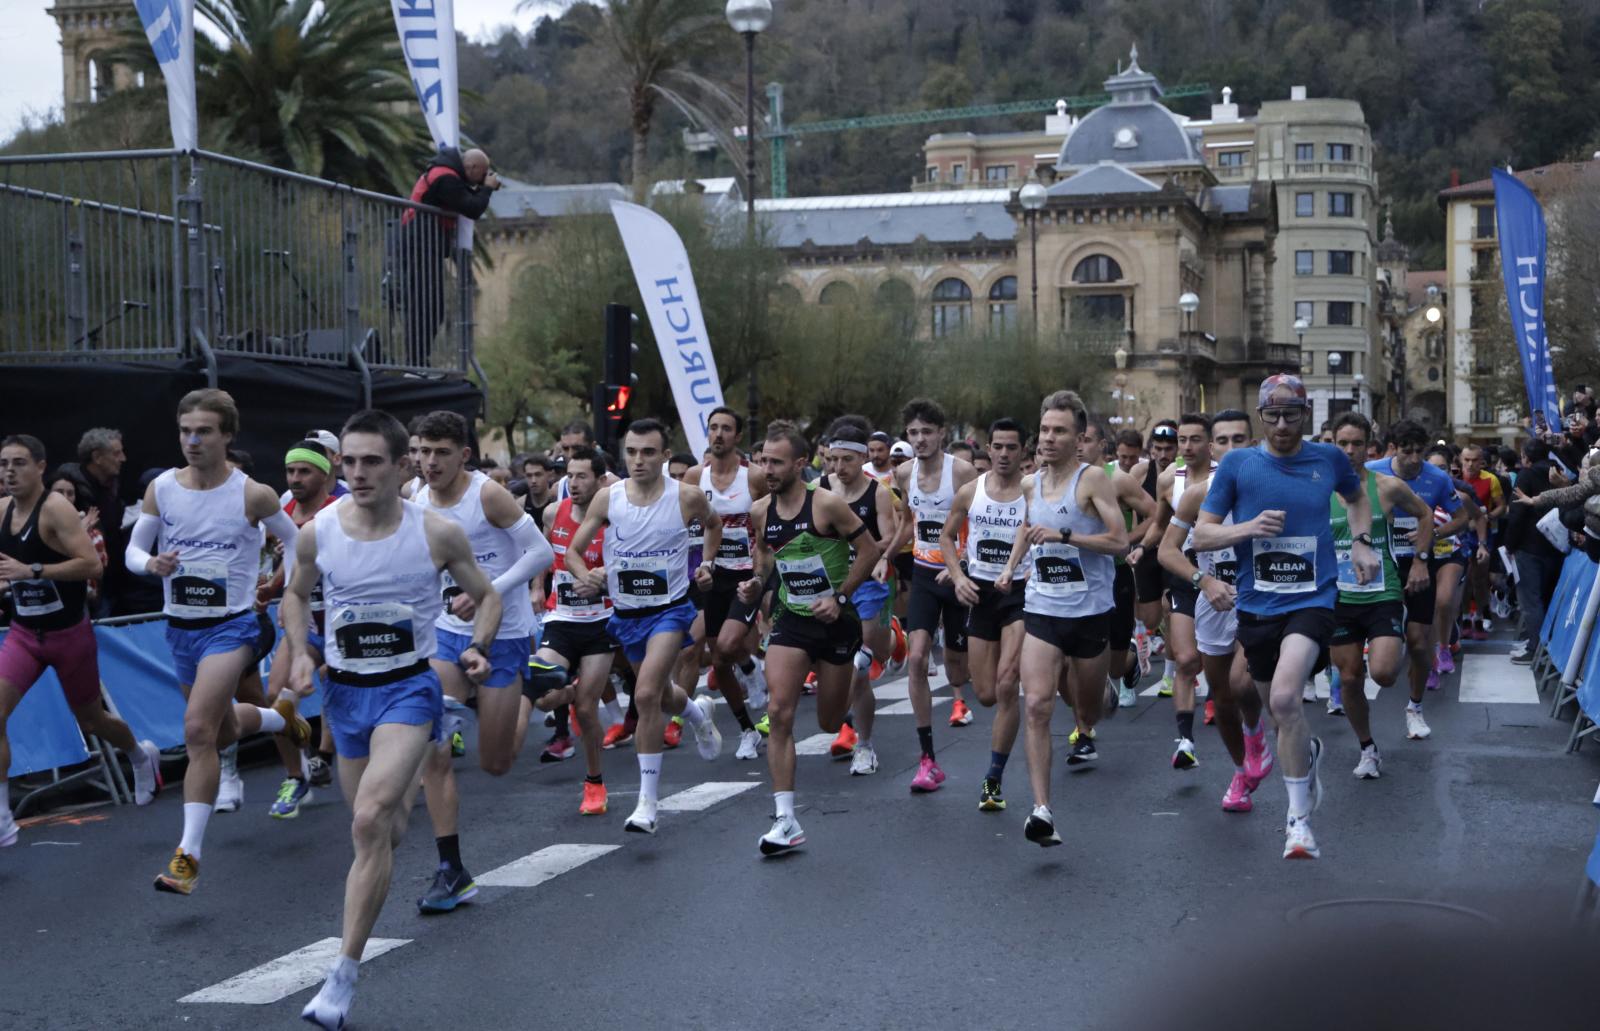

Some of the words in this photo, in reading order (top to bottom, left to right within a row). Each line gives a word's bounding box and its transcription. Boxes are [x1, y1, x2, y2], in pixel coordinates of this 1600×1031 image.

[986, 505, 992, 513] E
[1009, 507, 1017, 516] D
[975, 515, 1022, 528] PALENCIA
[981, 547, 998, 555] JOSÉ
[1046, 565, 1071, 574] JUSSI
[1269, 562, 1306, 571] ALBAN
[1222, 568, 1236, 576] RA
[789, 576, 823, 587] ANDONI
[1272, 574, 1298, 582] 10087
[185, 587, 215, 596] HUGO
[360, 610, 399, 620] ZURICH
[358, 632, 401, 644] MIKEL
